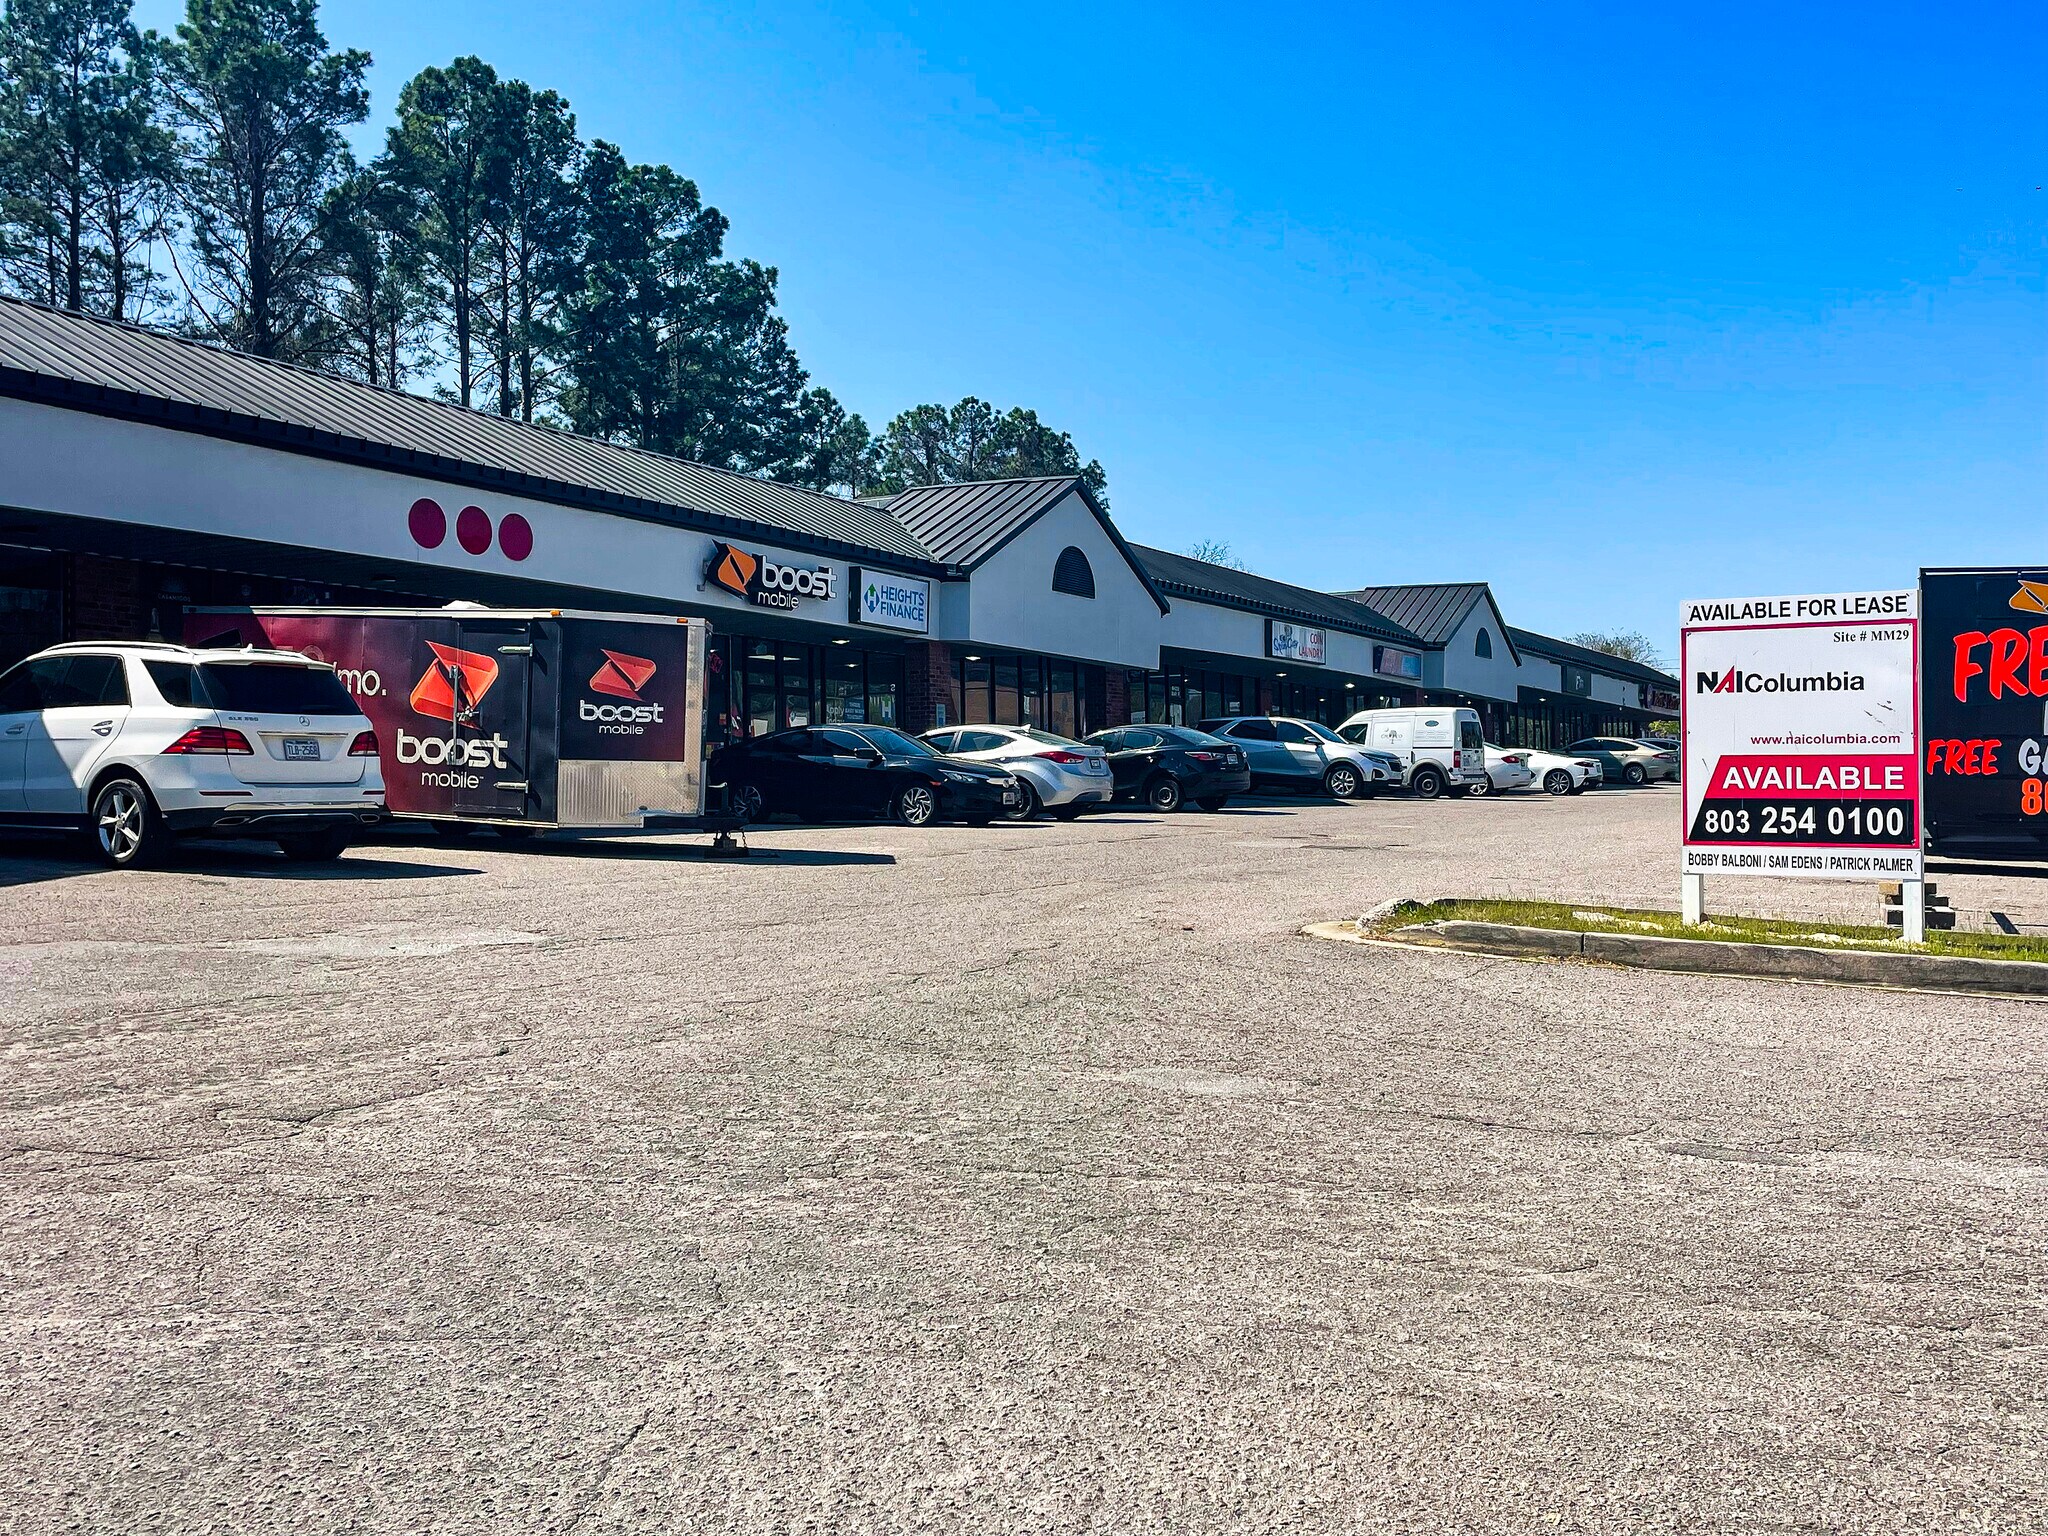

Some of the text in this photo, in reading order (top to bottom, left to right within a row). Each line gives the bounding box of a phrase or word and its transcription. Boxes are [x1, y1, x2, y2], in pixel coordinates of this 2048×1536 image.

[762, 555, 837, 599] boost
[758, 591, 800, 611] mobile
[880, 584, 925, 606] HEIGHTS
[880, 601, 924, 622] FINANCE
[1689, 595, 1908, 622] AVAILABLE FOR LEASE
[1310, 633, 1324, 645] COIN
[1833, 630, 1909, 643] Site # MM29
[1298, 646, 1323, 659] LAUNDRY
[580, 700, 664, 723] boost
[598, 724, 644, 735] mobile
[1751, 733, 1900, 745] www.naicolumbia.com
[396, 728, 508, 768] boost
[1927, 739, 2002, 776] FREE
[421, 771, 480, 789] mobile
[1722, 766, 1904, 790] AVAILABLE
[1705, 807, 1903, 836] 803 254 0100
[1688, 853, 1720, 866] BOBBY
[1722, 854, 1761, 867] BALBONI
[1769, 856, 1789, 868] SAM
[1792, 856, 1822, 869] EDENS
[1830, 857, 1870, 870] PATRICK
[1873, 858, 1913, 871] PALMER
